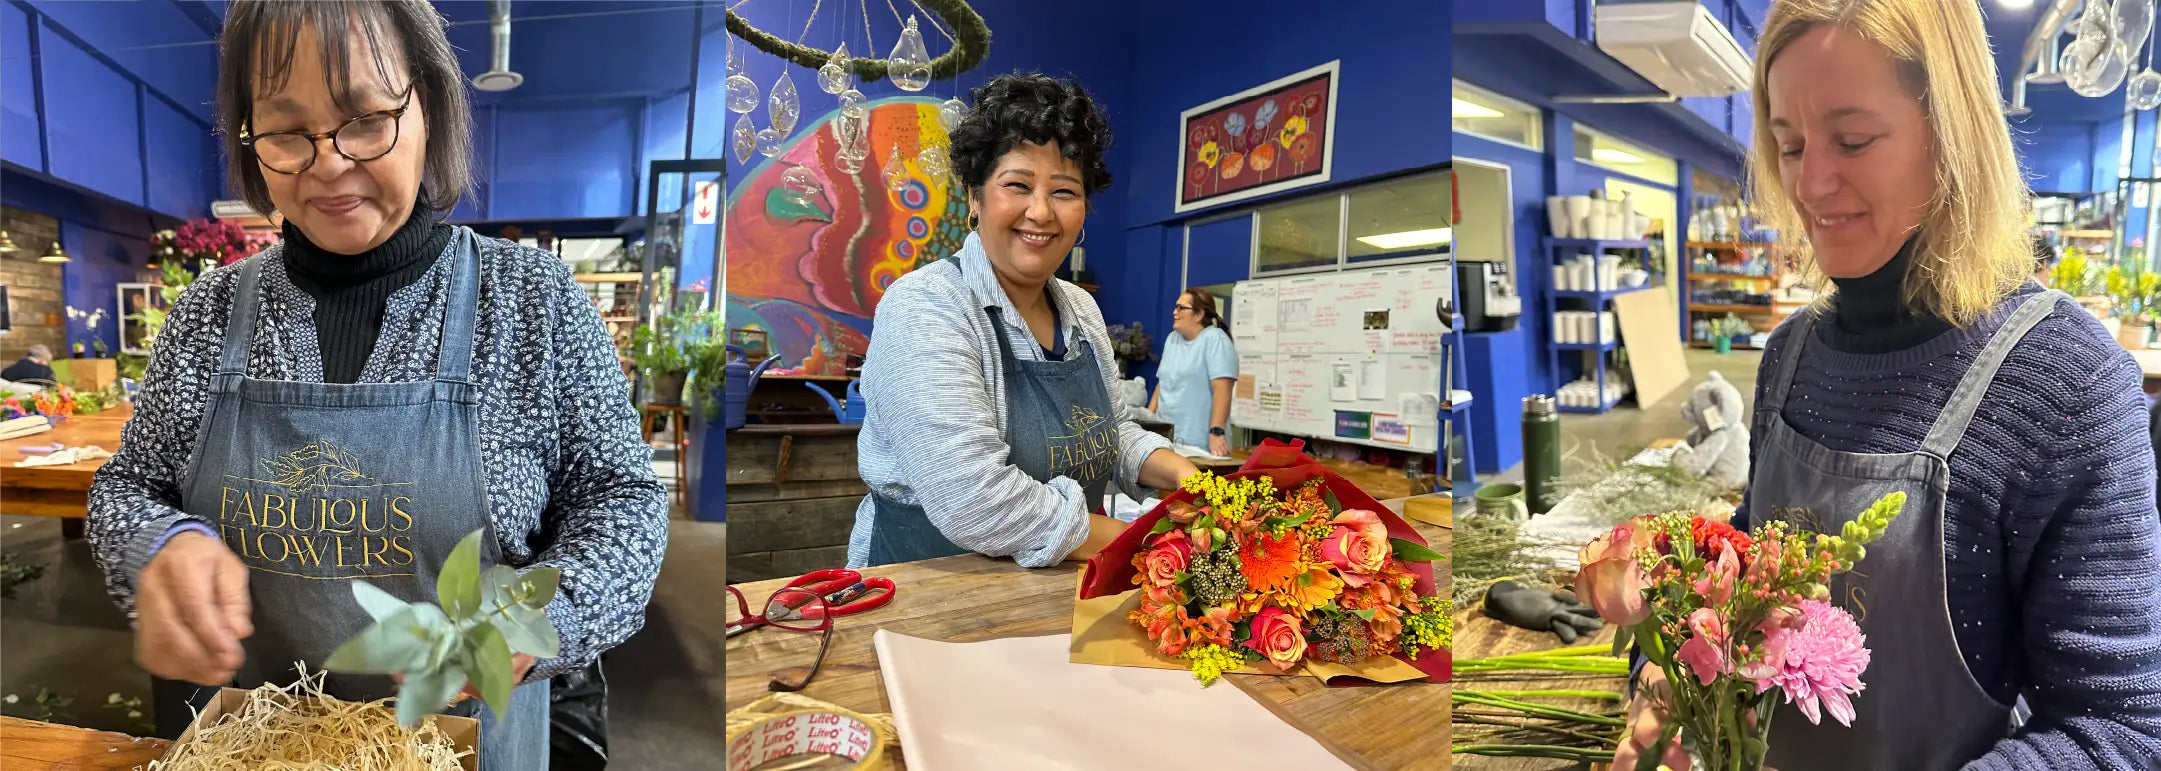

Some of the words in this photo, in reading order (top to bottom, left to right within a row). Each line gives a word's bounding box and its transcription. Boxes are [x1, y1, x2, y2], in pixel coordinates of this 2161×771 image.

[1049, 426, 1117, 469] FABULOU
[220, 486, 414, 534] FABULOUS
[220, 523, 414, 568] FLOWERS
[808, 713, 840, 725] LiteO
[808, 726, 839, 738] LiteO
